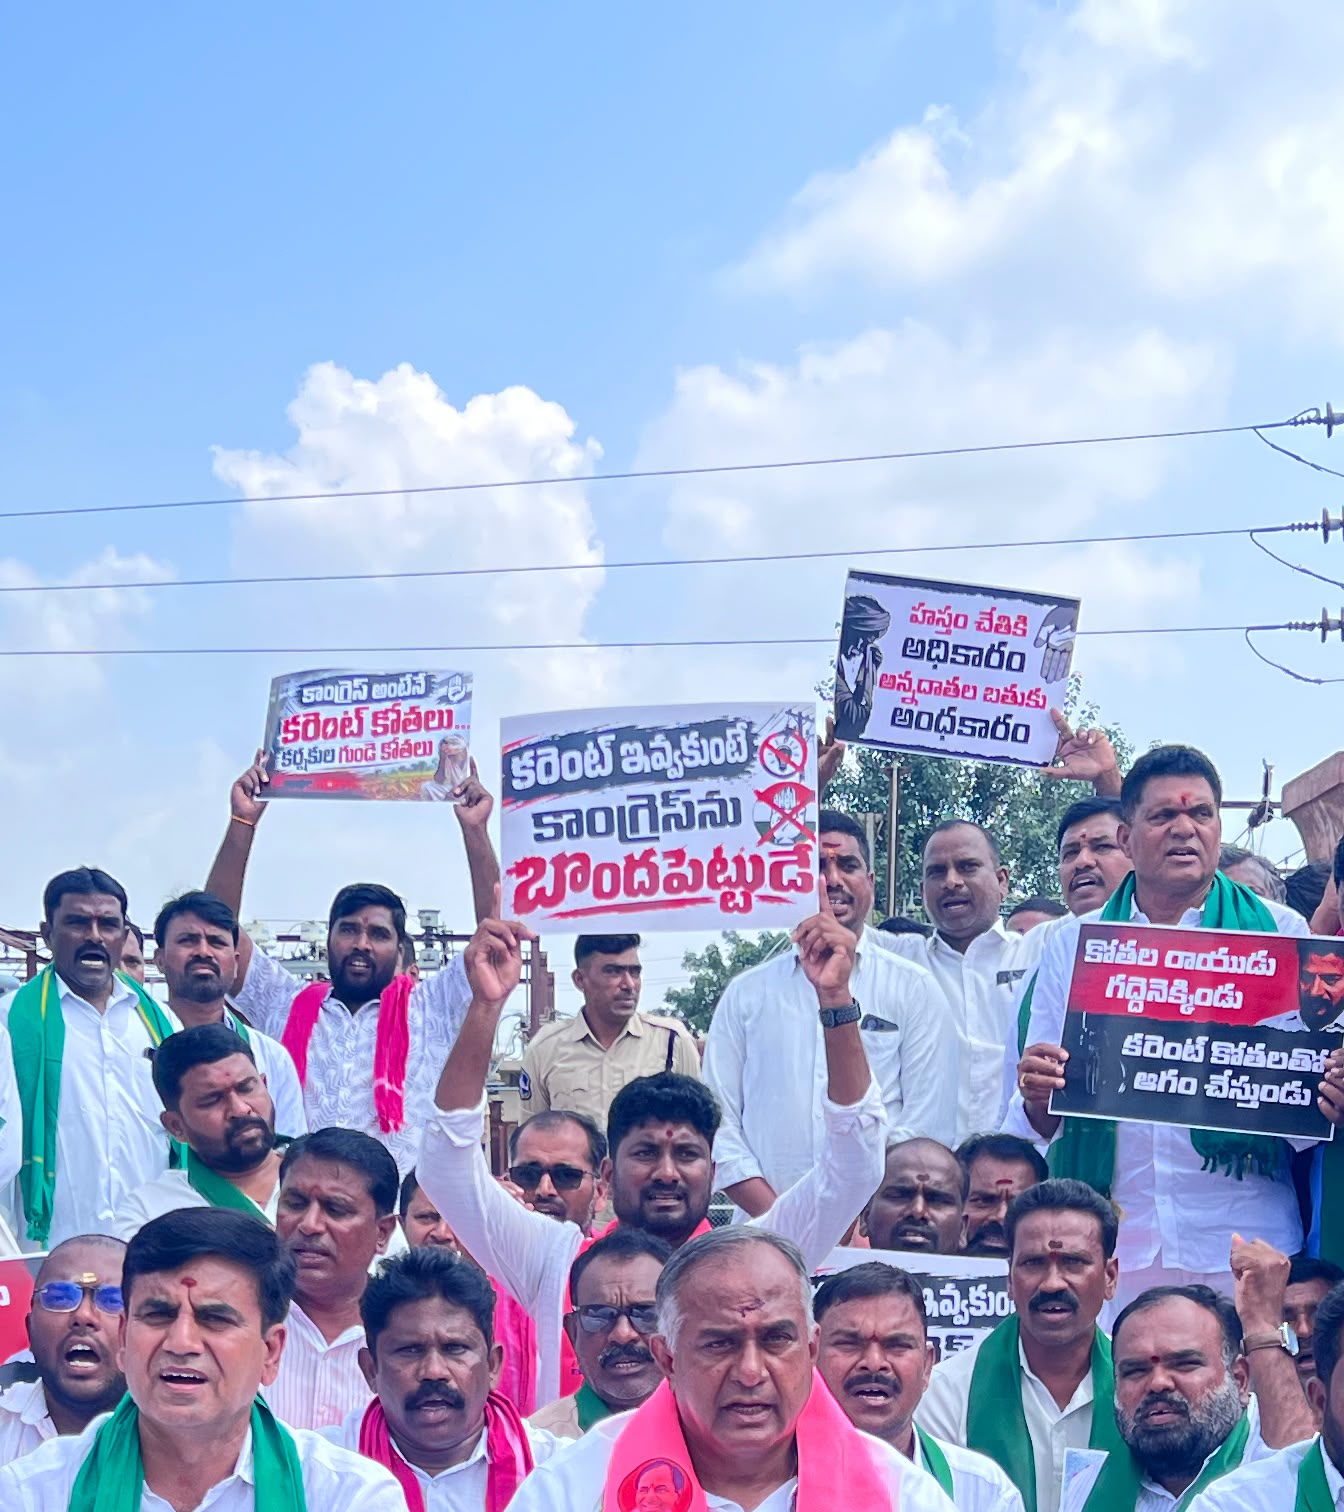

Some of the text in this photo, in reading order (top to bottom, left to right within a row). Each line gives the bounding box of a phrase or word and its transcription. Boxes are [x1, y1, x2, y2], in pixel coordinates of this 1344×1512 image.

[909, 602, 1028, 638] హస్తం చేతికి
[902, 637, 1026, 672] అధికారం
[302, 678, 369, 705] కాంగ్రెస్
[879, 671, 1047, 710] అన్నదాతల బతుకు
[281, 707, 369, 745] కరెంట్
[890, 706, 1030, 741] అంధకారం
[380, 737, 433, 762] కోతలు
[511, 721, 749, 791] కరెంట్ ఇవ్వకుంటే
[1084, 938, 1276, 977] కోతల రాయుడు
[1121, 1033, 1330, 1073] కరెంట్ కోతలతో
[1133, 1069, 1312, 1109] ఆగం చేస్తుండు
